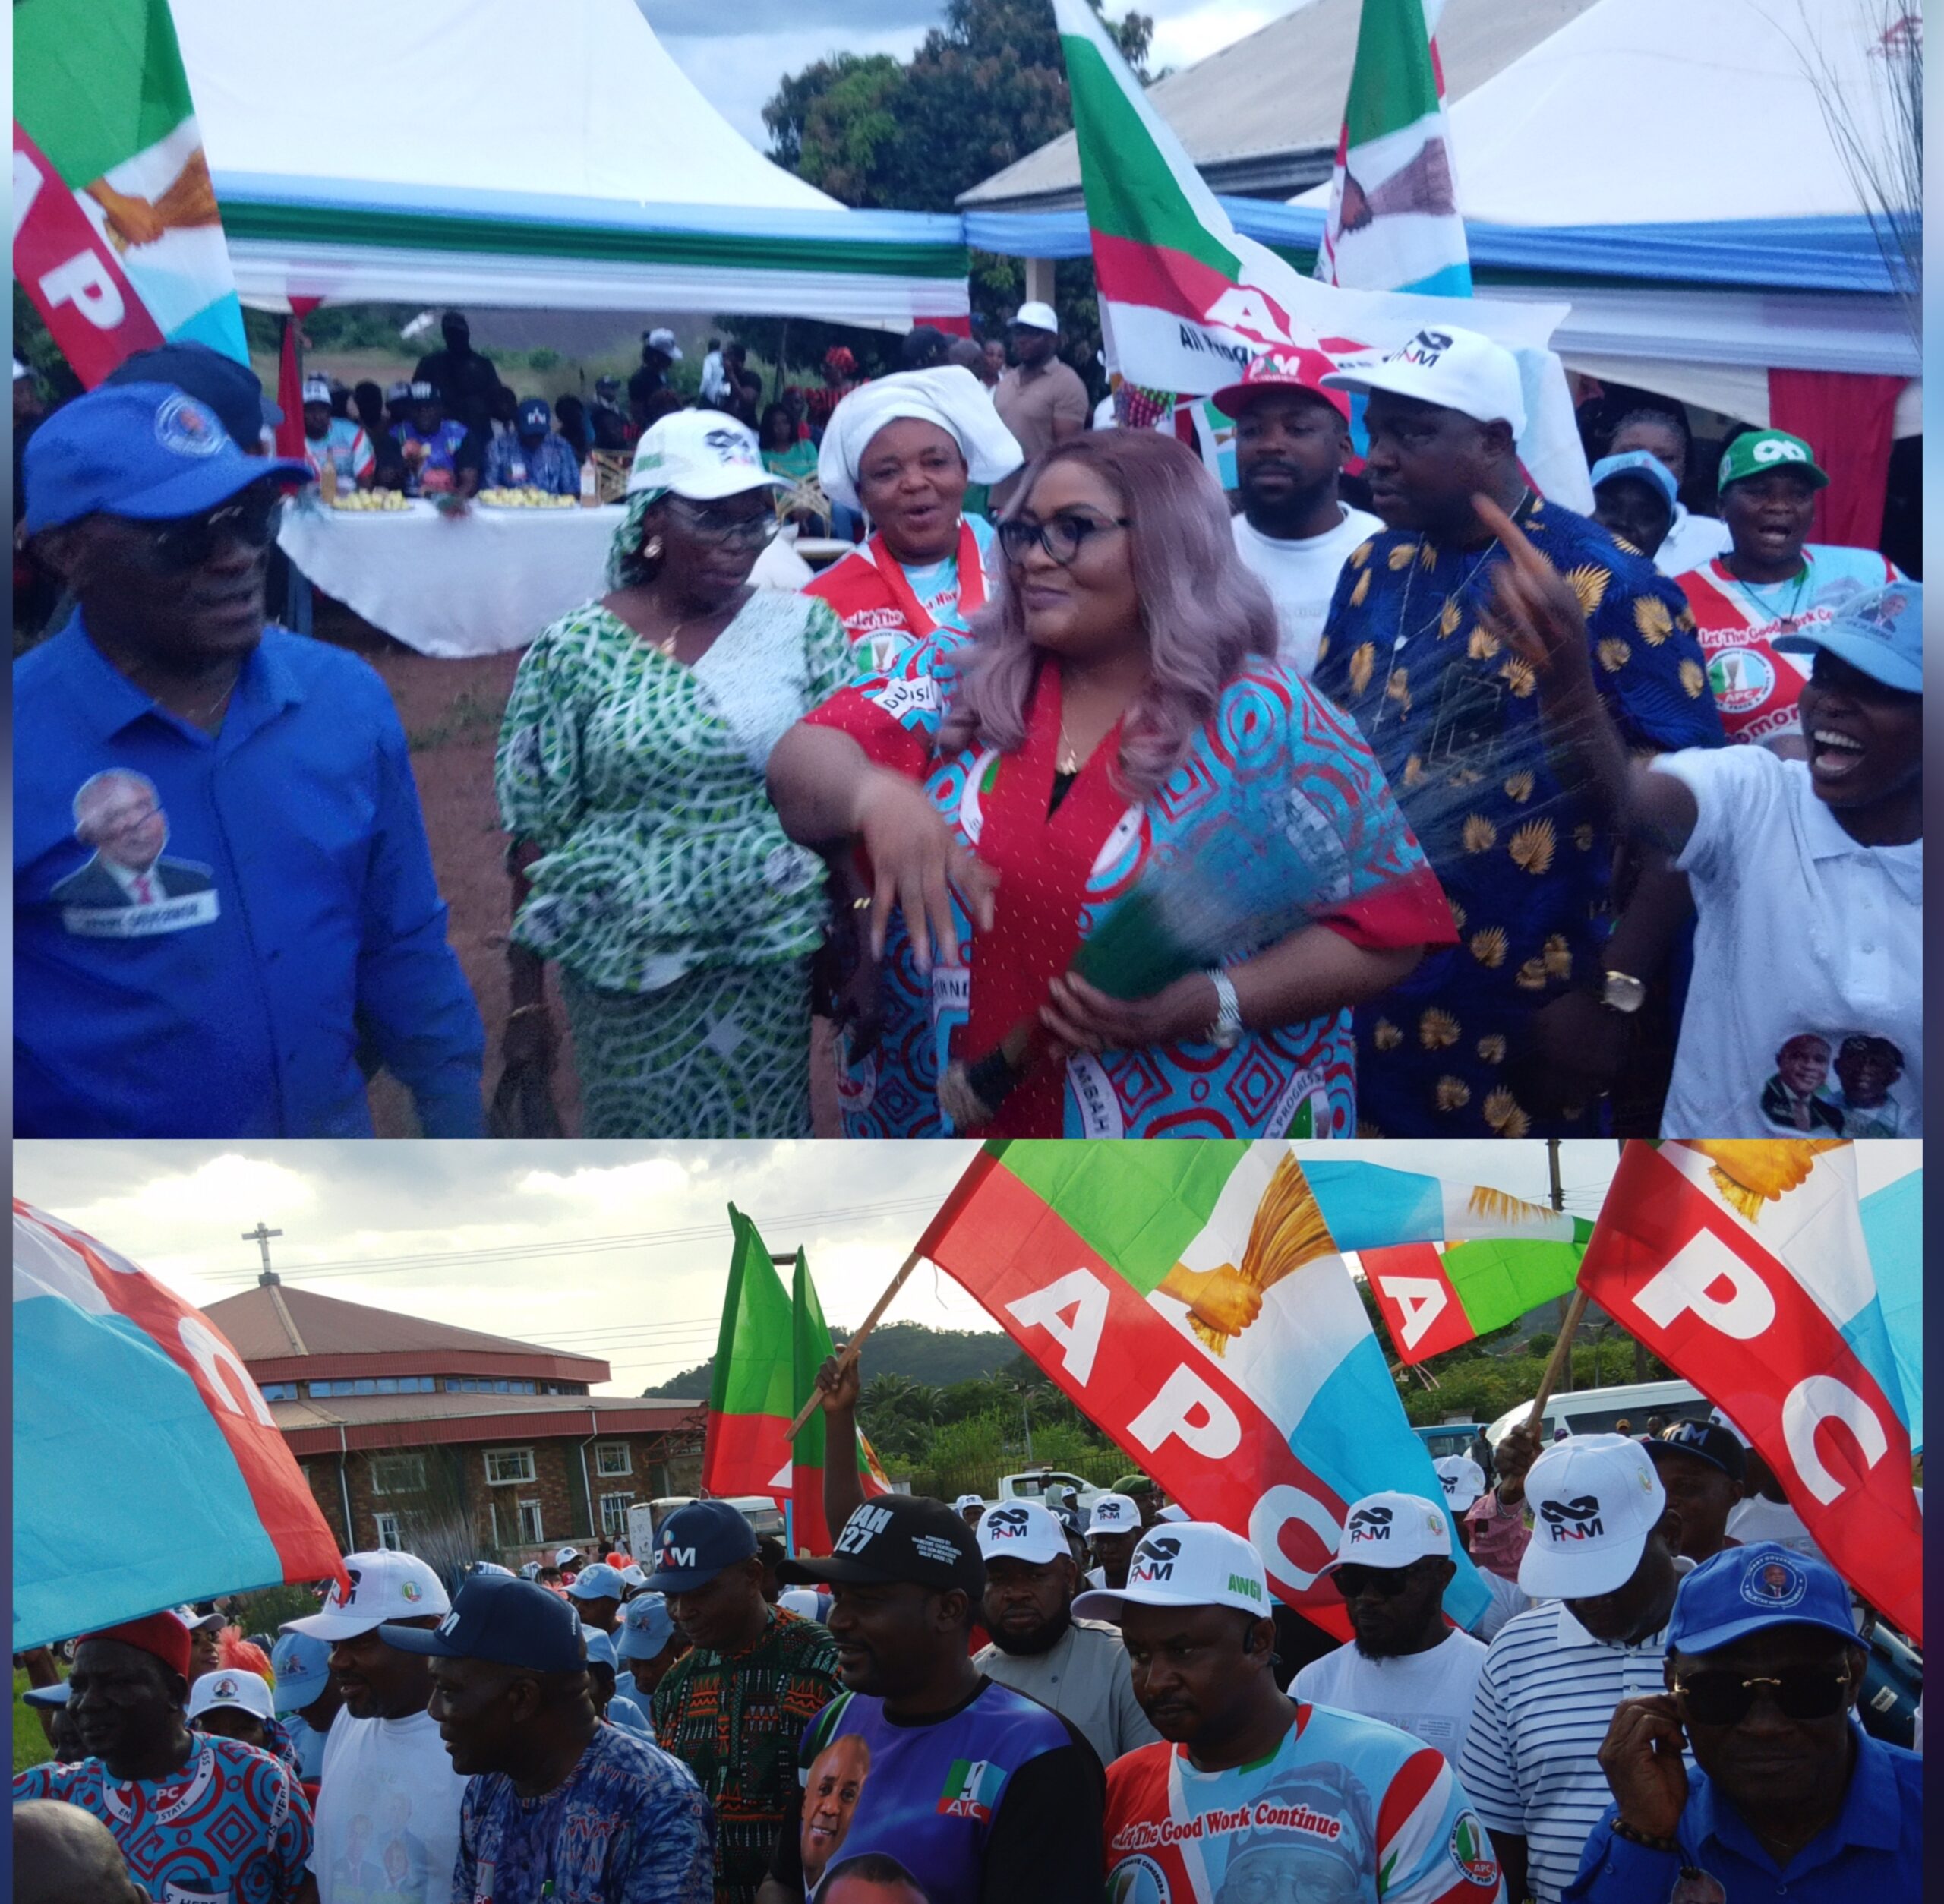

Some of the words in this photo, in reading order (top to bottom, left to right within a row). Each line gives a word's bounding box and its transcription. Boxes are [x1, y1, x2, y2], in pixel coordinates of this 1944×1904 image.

[1179, 324, 1201, 352] All
[1701, 630, 1720, 645] Let
[1723, 627, 1746, 644] The
[1748, 620, 1780, 640] Good
[1724, 690, 1753, 704] APC
[1068, 1063, 1110, 1135] MBAH
[1005, 1267, 1349, 1592] APC
[160, 1798, 188, 1820] STATE
[1136, 1823, 1160, 1847] The
[1160, 1815, 1203, 1842] Good
[1206, 1806, 1251, 1834] Work
[1254, 1803, 1341, 1839] Continue
[1474, 1864, 1491, 1873] APC
